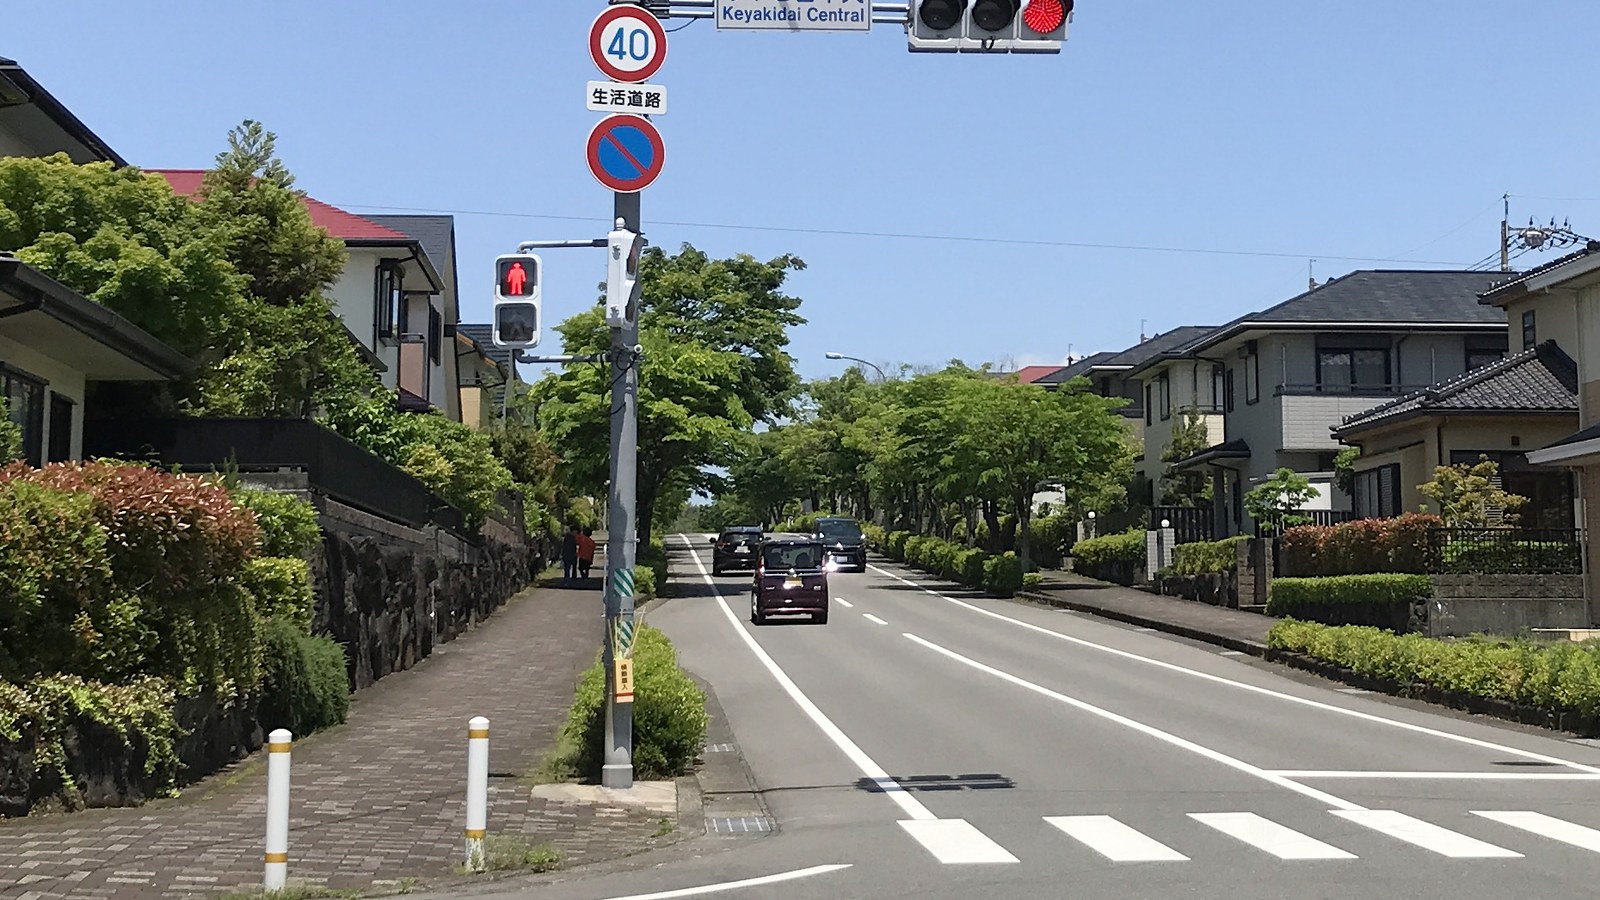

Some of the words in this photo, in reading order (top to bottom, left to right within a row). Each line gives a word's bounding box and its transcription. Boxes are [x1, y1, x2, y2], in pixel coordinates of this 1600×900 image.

[723, 6, 801, 23] Keyakidai
[807, 7, 864, 22] Central
[607, 27, 649, 61] 40
[592, 87, 662, 109] 生活道路
